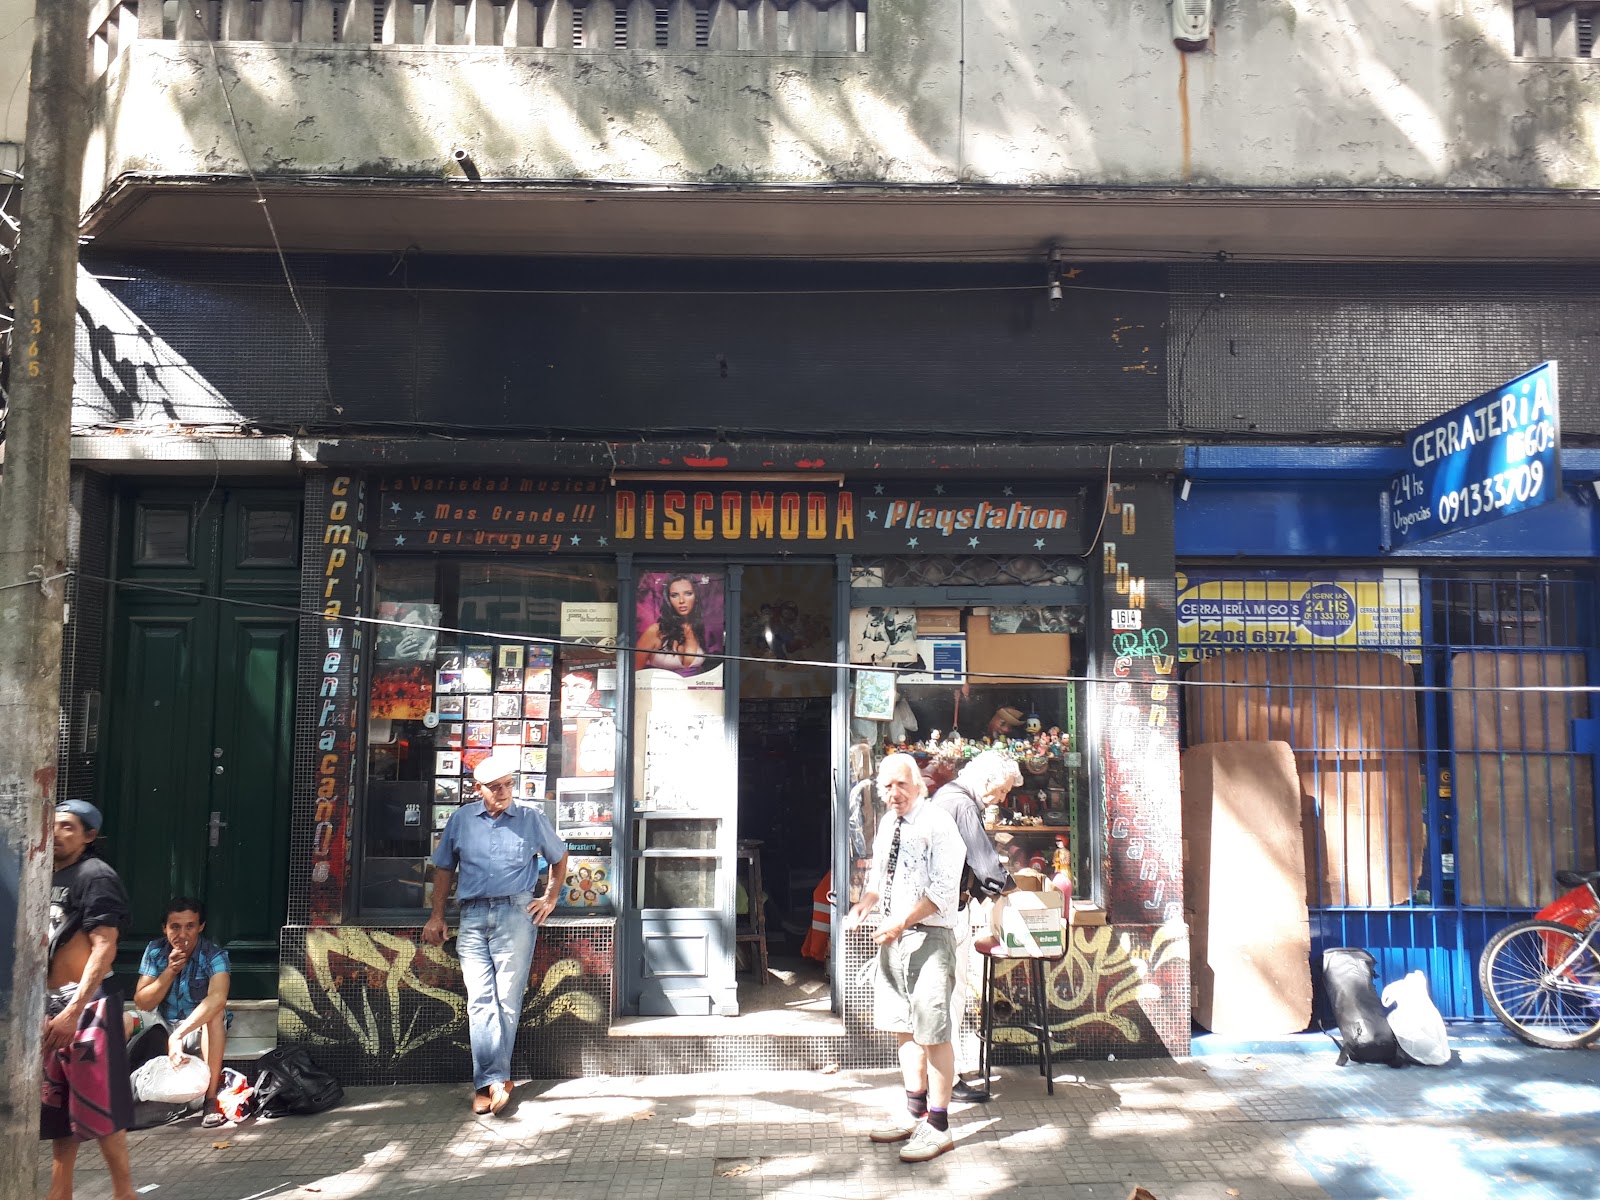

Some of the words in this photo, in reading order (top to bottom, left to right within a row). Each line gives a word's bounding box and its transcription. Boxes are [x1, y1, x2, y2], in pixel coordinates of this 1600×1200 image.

[28, 299, 42, 377] 1365
[409, 476, 511, 492] Variedad
[1438, 461, 1544, 525] 091333709
[434, 503, 478, 520] Mas
[614, 490, 856, 540] DISCOMODA
[883, 499, 1069, 537] Playstation
[1107, 483, 1136, 536] CD
[427, 530, 463, 545] Del
[474, 530, 563, 552] Uruguay
[1103, 541, 1146, 609] ROM
[1199, 630, 1247, 643] 2408
[1252, 630, 1298, 643] 6974
[318, 627, 344, 751] venta
